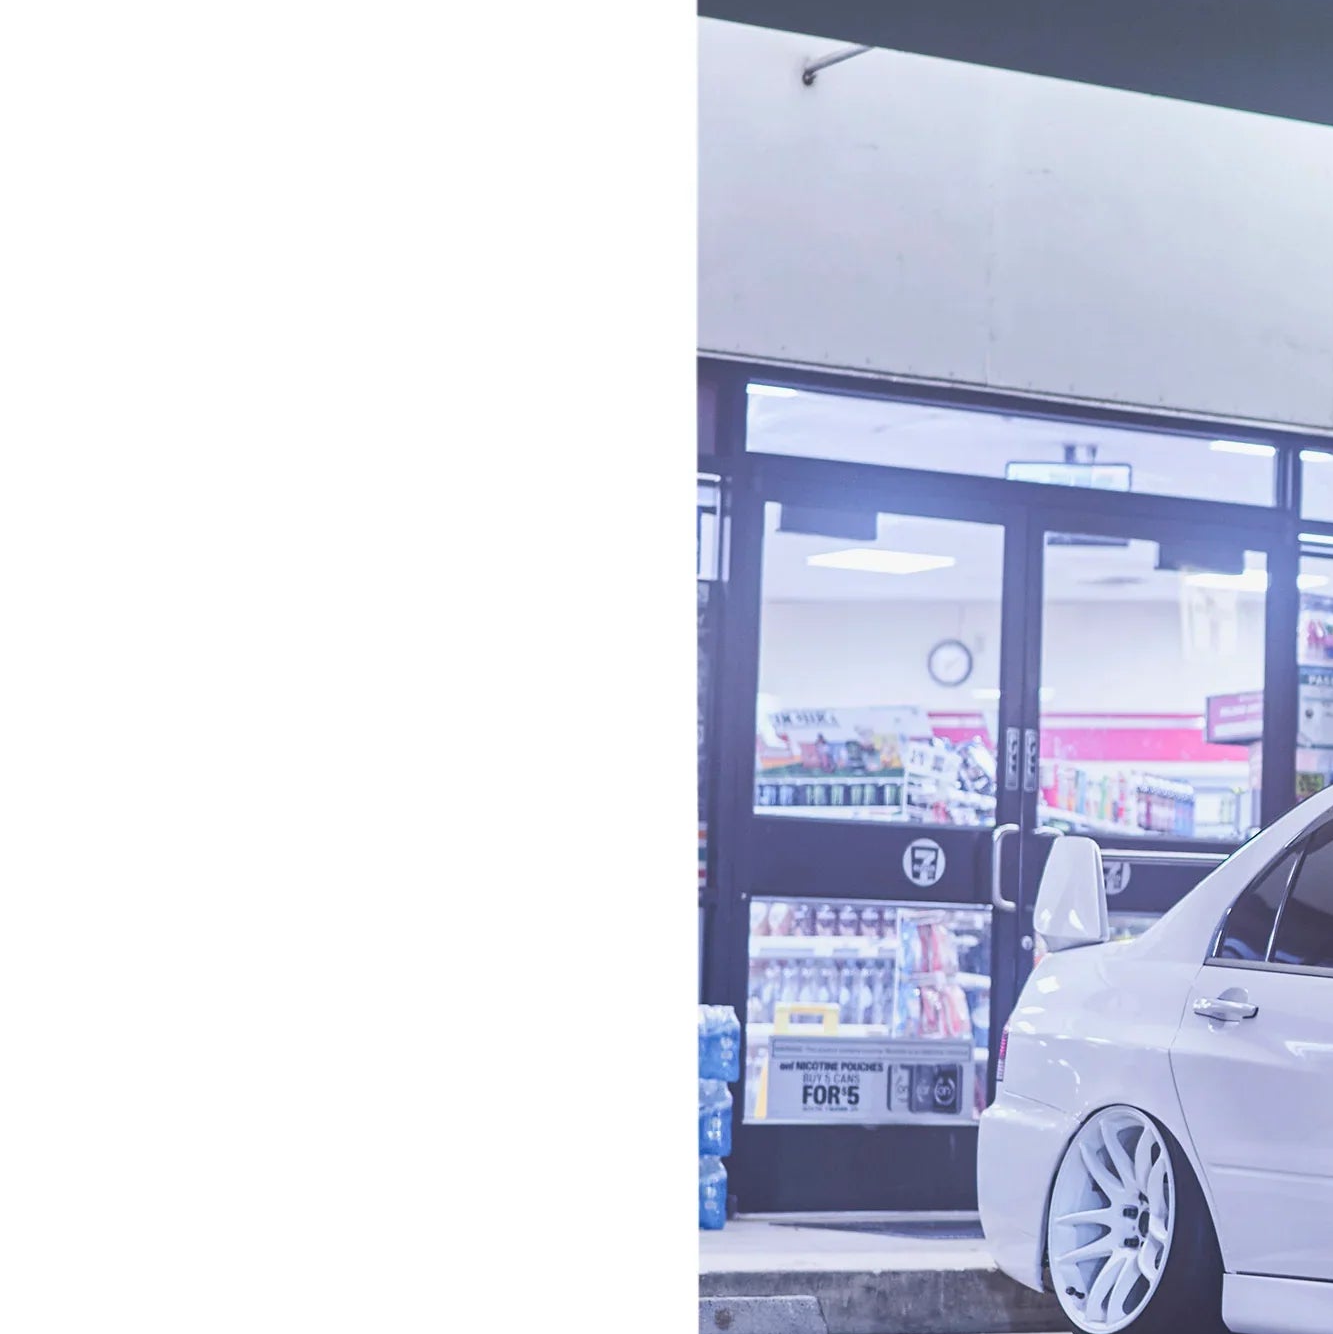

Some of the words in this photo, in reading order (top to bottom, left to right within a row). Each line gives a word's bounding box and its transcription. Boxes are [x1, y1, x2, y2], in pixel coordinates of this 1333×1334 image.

[796, 1061, 838, 1071] NICOTINE
[841, 1062, 884, 1073] POUCHES
[803, 1073, 822, 1083] BUY
[833, 1074, 860, 1083] CANS
